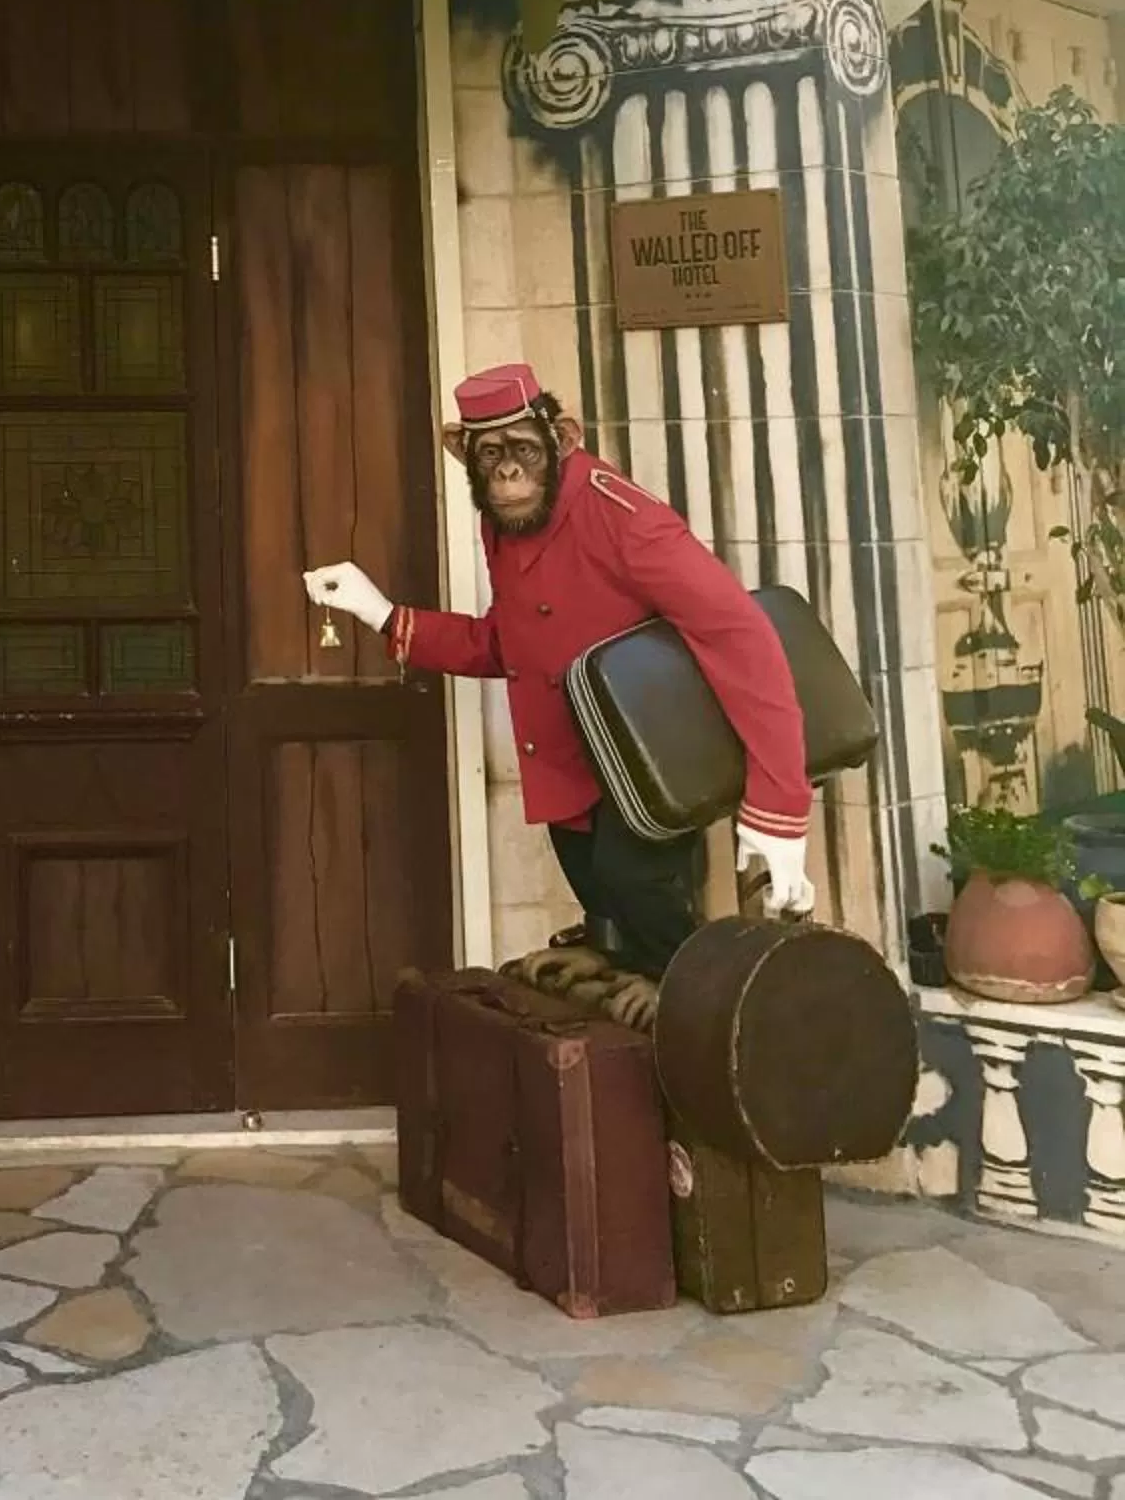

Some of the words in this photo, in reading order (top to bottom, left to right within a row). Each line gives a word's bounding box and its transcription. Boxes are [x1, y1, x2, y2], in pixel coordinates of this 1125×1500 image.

[679, 210, 708, 231] THE
[631, 232, 717, 266] WALLED
[723, 229, 761, 260] OFF
[672, 264, 721, 286] HOTEL
